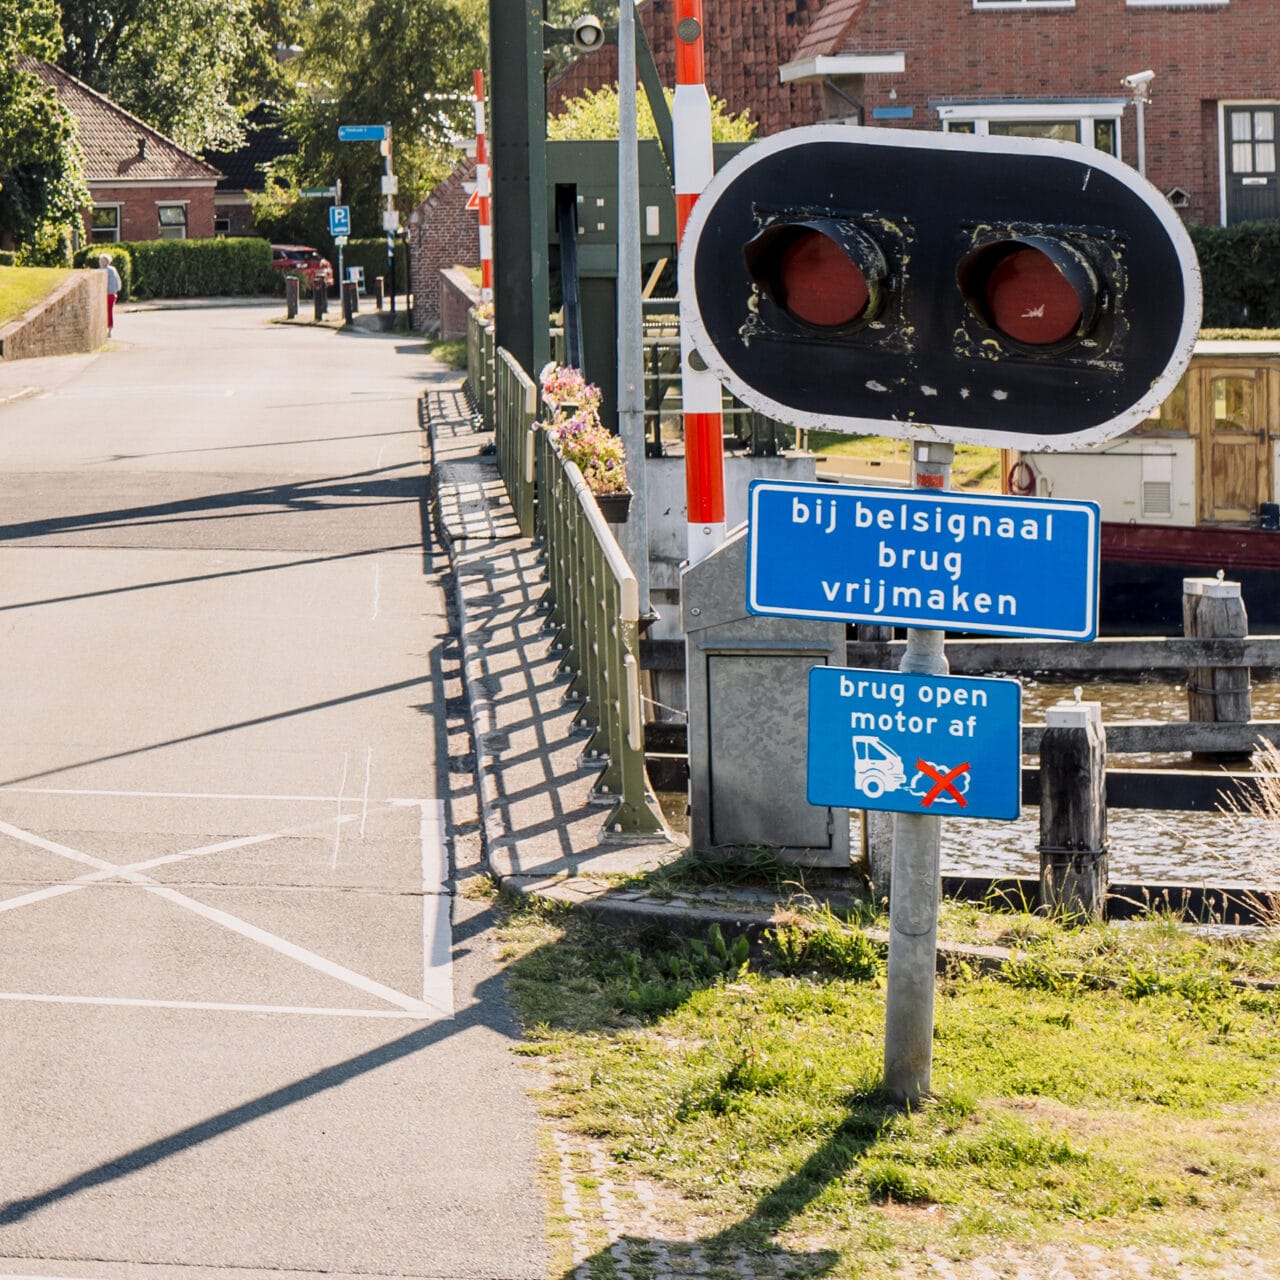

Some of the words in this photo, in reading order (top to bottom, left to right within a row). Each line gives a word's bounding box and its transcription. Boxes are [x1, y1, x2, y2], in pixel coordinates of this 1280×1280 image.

[791, 496, 837, 534] bij
[855, 500, 1054, 543] belsignaal
[878, 540, 963, 581] brug
[821, 578, 1017, 616] vrijmaken
[840, 674, 905, 708] brug
[918, 685, 988, 708] open
[850, 710, 938, 734] motor
[948, 715, 977, 737] af
